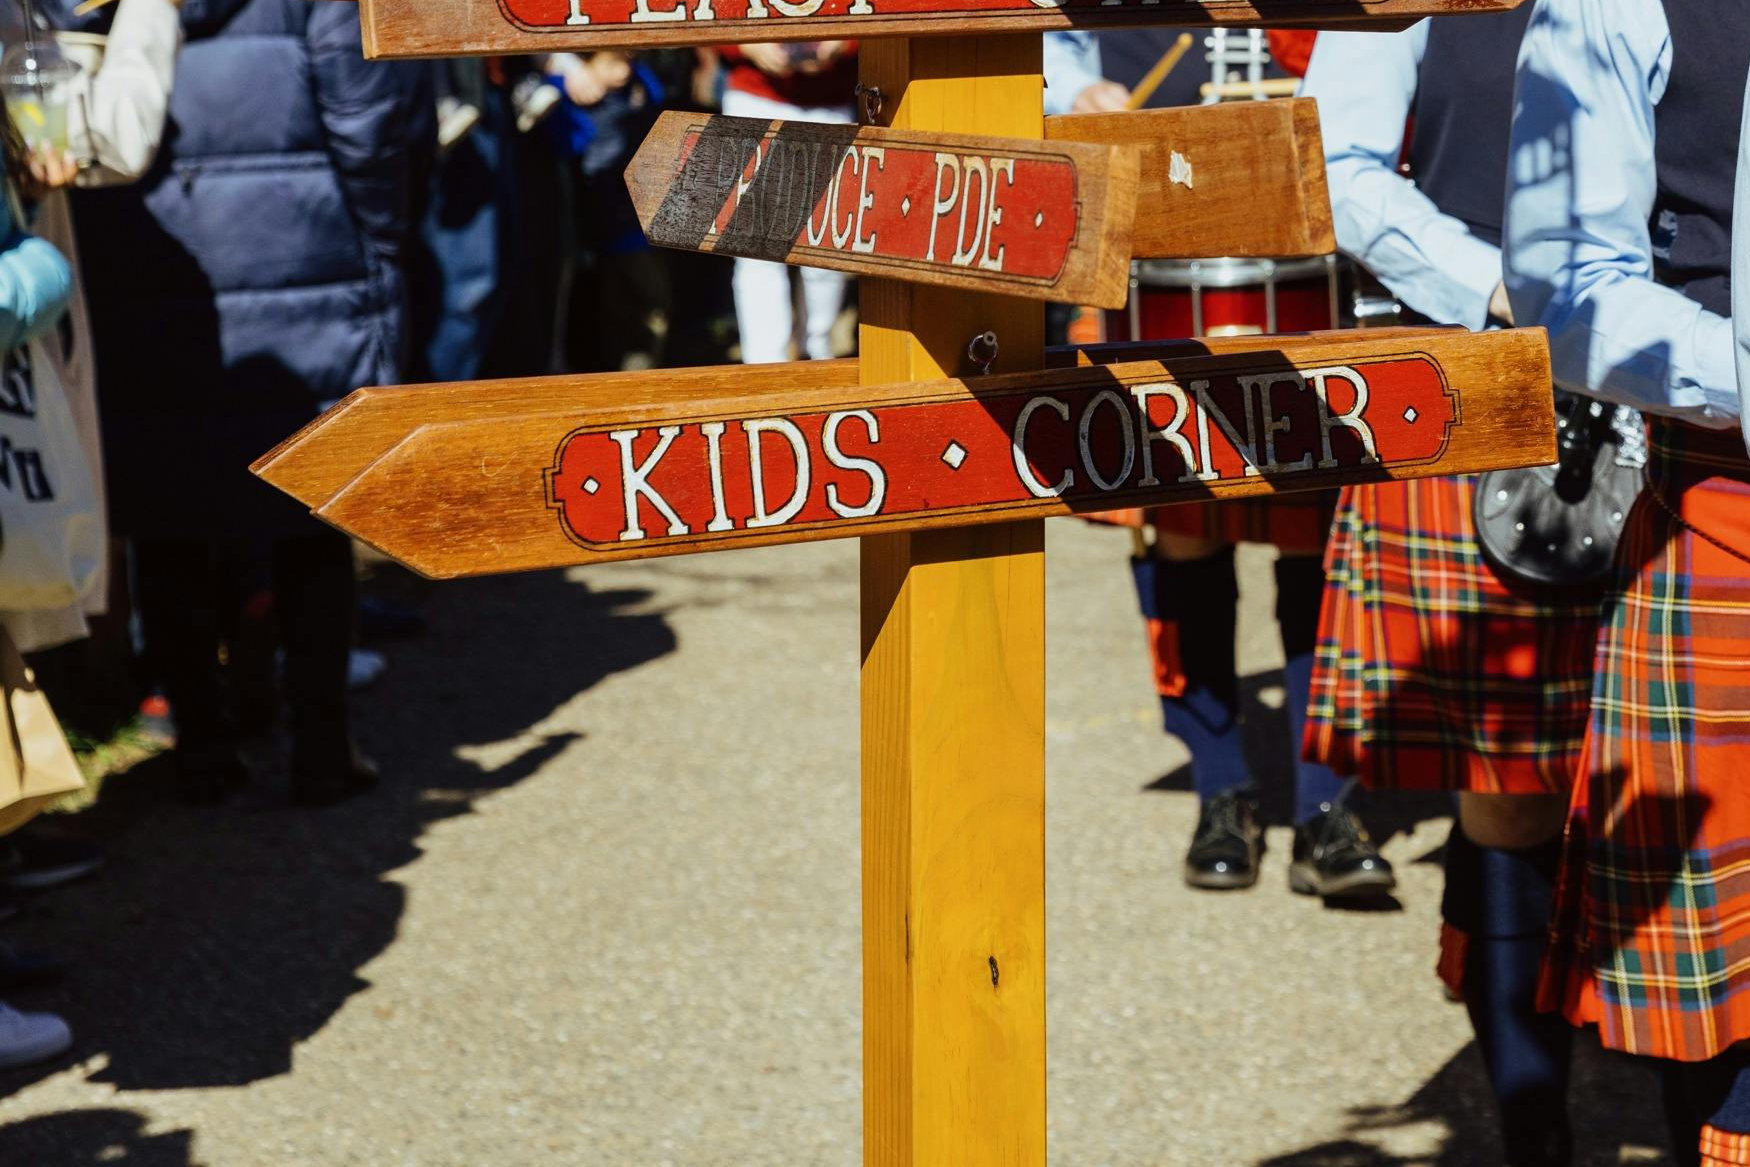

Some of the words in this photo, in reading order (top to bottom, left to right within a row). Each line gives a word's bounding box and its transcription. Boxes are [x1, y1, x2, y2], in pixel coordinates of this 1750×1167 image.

[708, 135, 885, 254] PRODUCE
[926, 151, 1015, 272] PDE
[608, 408, 887, 542] KIDS
[1010, 364, 1380, 499] CORNER
